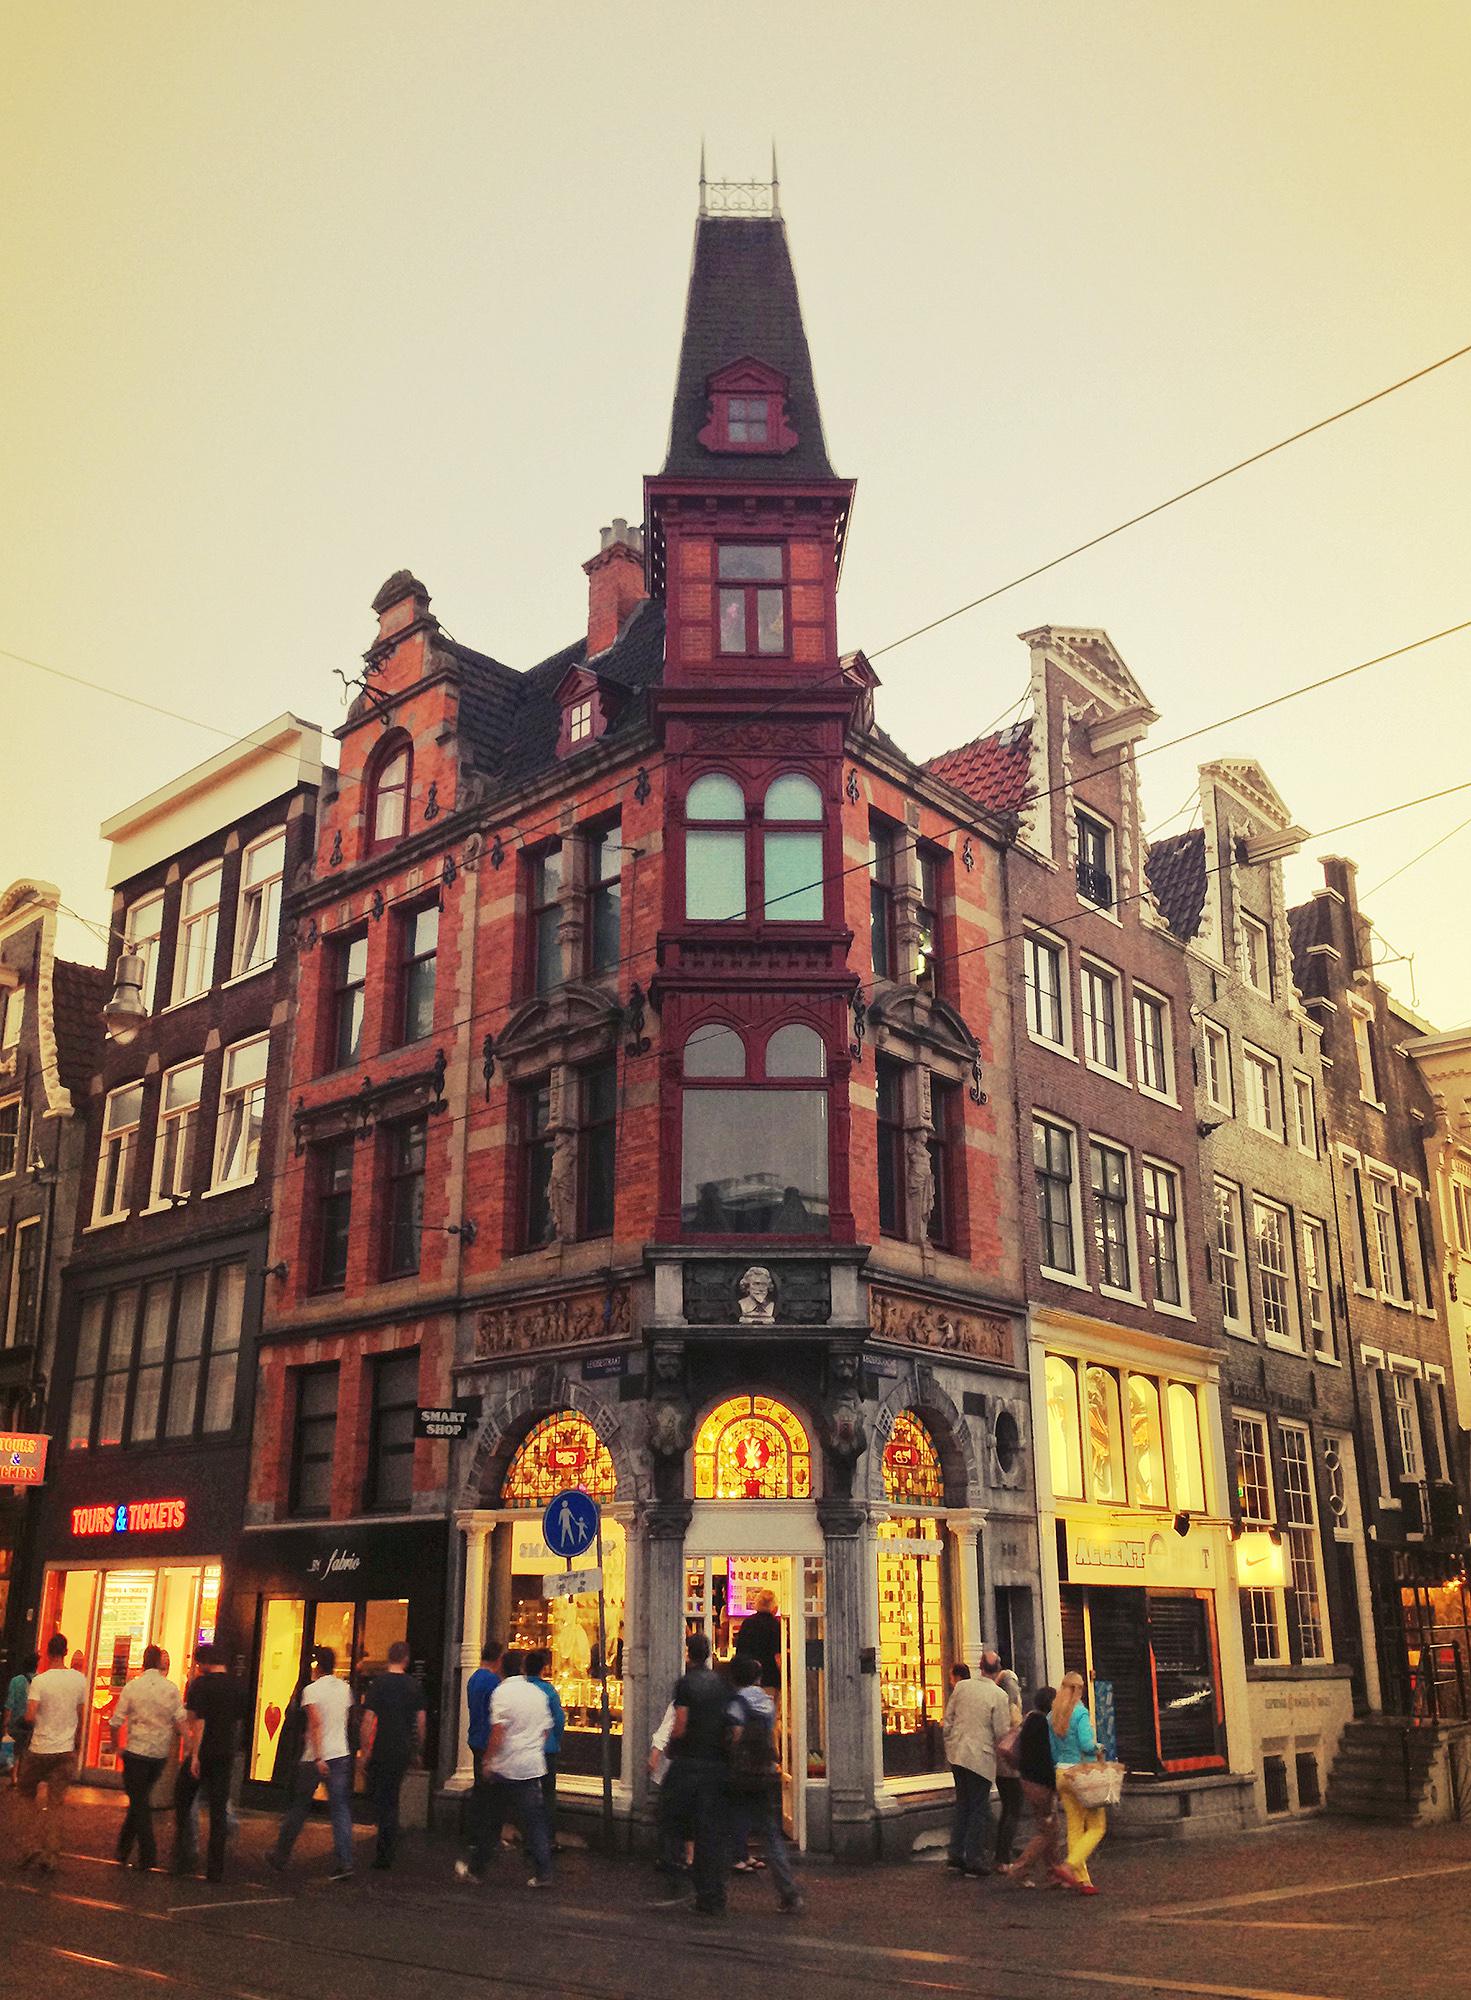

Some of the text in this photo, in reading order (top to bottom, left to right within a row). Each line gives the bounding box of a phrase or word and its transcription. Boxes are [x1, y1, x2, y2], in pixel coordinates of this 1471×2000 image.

[421, 1411, 467, 1422] SMART
[426, 1424, 462, 1435] SHOP
[10, 1452, 21, 1466] &
[73, 1500, 186, 1534] TOURS & TICKETS
[1075, 1537, 1146, 1569] ACCENT
